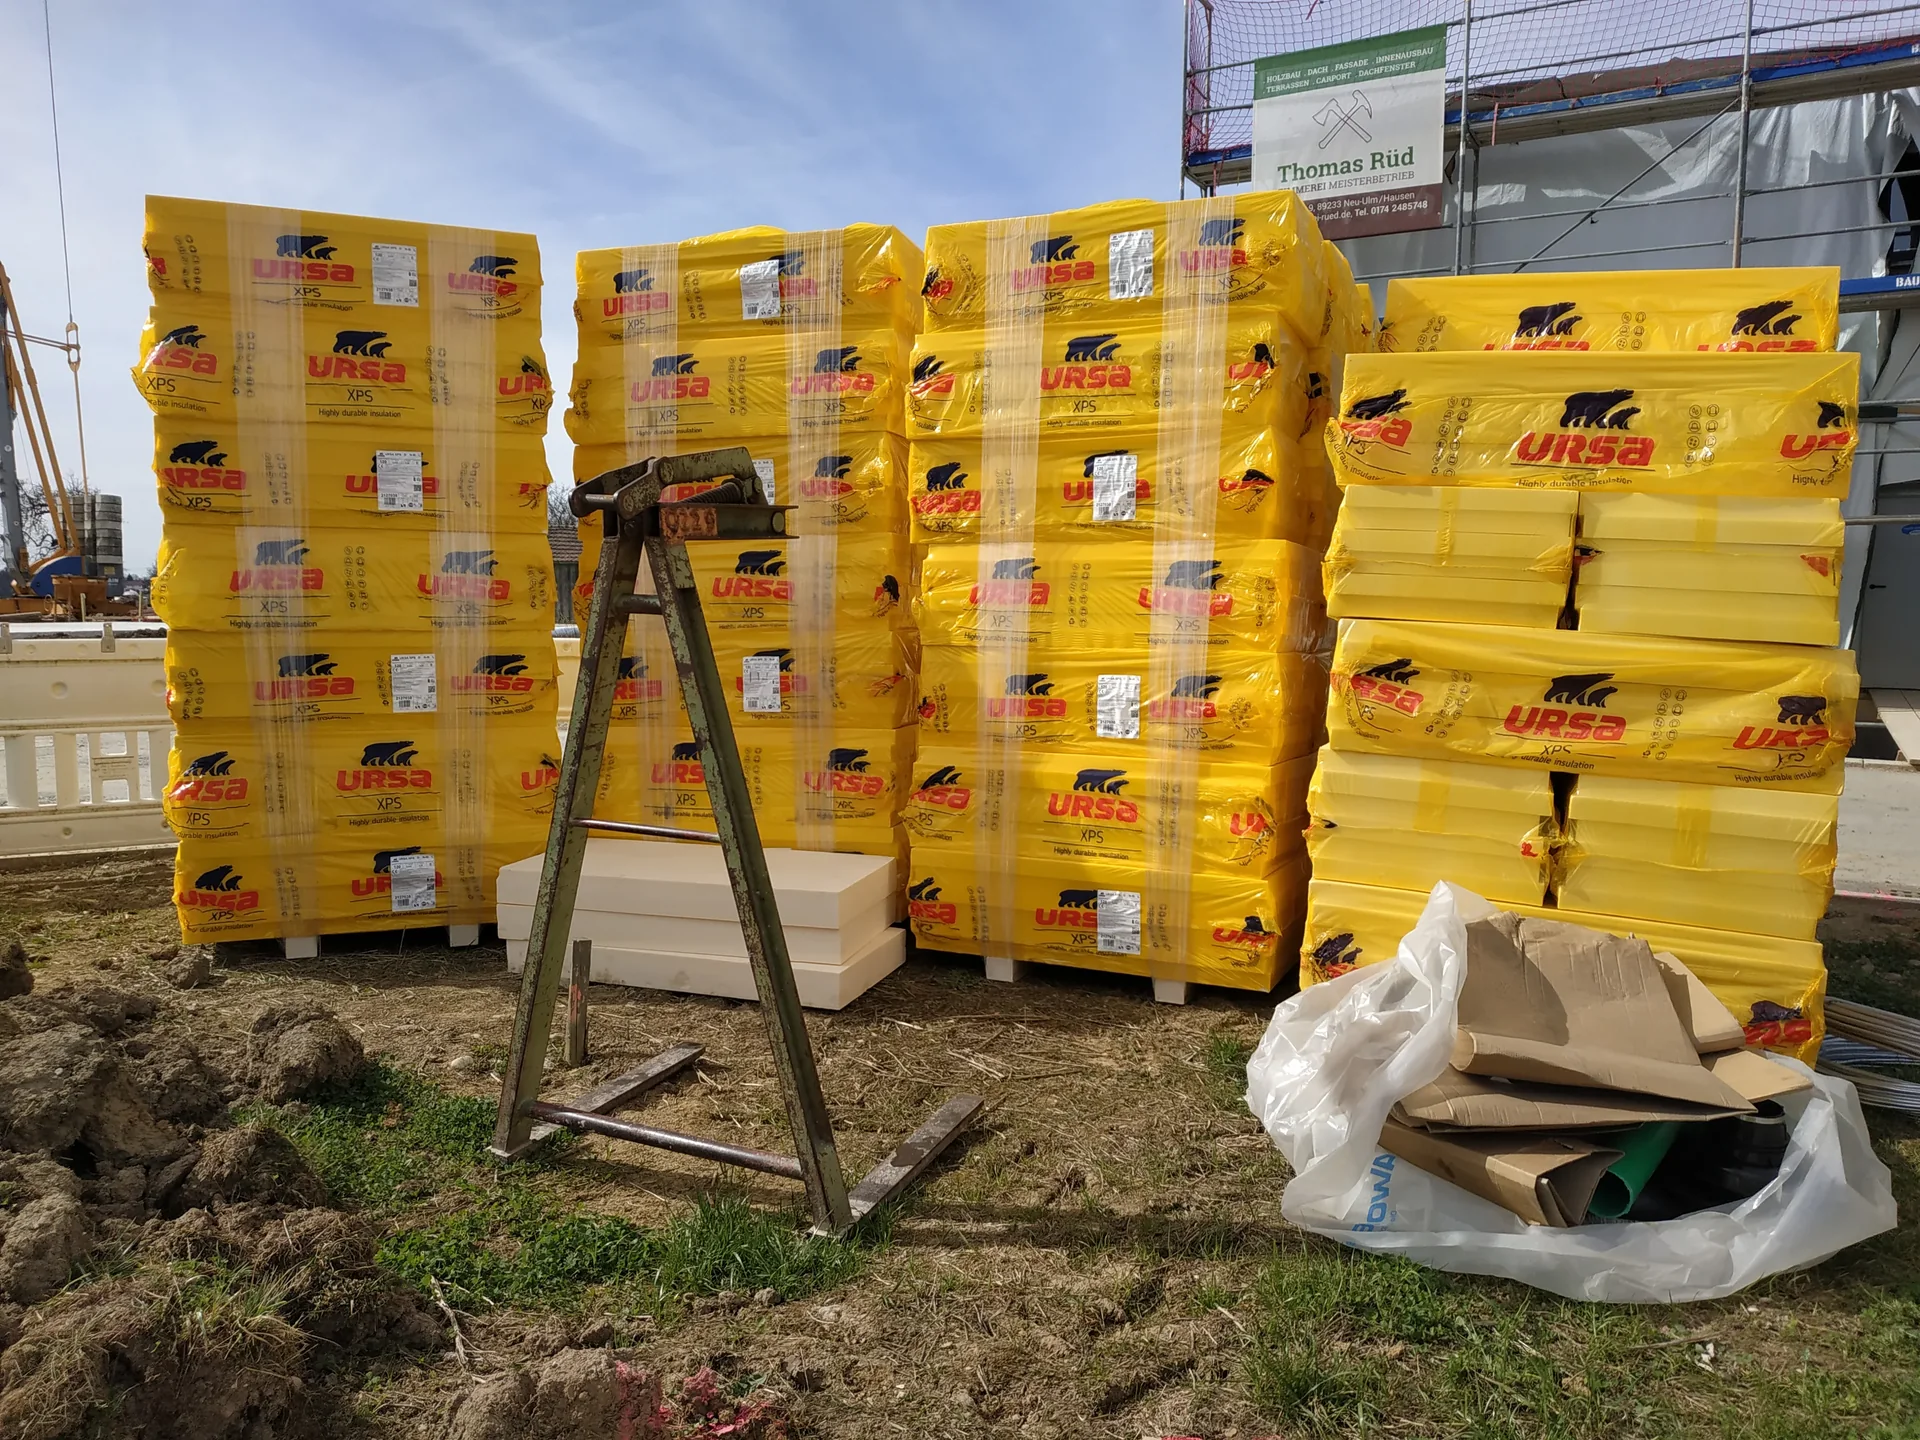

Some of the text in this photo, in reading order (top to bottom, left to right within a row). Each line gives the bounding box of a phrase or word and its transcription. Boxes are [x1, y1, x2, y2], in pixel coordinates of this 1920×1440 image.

[1267, 48, 1434, 83] HOLZBAU DACH FASSADE INNENAUSBAU
[1266, 62, 1415, 93] TERRASSEN CARPORT DACHFENSTER
[1278, 147, 1414, 182] Thomas Rüd
[1278, 171, 1414, 194] MEREI MEISTERBETRIEB
[1317, 201, 1341, 210] 89233
[1344, 192, 1415, 206] Neu-Ulm/Hausen
[1355, 208, 1369, 217] Tel.
[1371, 205, 1389, 215] 0174
[1392, 201, 1427, 212] 2485748
[1219, 275, 1240, 290] XPS
[294, 287, 321, 297] XPS
[781, 304, 800, 314] XPS
[628, 319, 645, 330] XPS
[147, 378, 175, 392] XPS
[348, 390, 373, 402] XPS
[171, 399, 206, 412] insulation
[825, 402, 846, 412] XPS
[1073, 400, 1096, 412] XPS
[319, 407, 340, 417] Highly
[659, 410, 679, 422] XPS
[1519, 479, 1546, 488] Highly
[187, 497, 211, 508] XPS
[260, 601, 287, 613] XPS
[457, 604, 481, 614] XPS
[742, 608, 764, 618] XPS
[991, 616, 1013, 627] XPS
[1175, 620, 1200, 631] XPS
[613, 680, 662, 700] RSA
[487, 696, 508, 704] XPS
[295, 704, 320, 714] XPS
[620, 706, 636, 716] XPS
[1016, 725, 1036, 735] XPS
[1185, 728, 1208, 739] XPS
[1540, 745, 1572, 755] XPS
[1554, 758, 1594, 769] insulation
[651, 764, 704, 783] URS
[377, 798, 402, 810] XPS
[676, 794, 696, 806] XPS
[186, 813, 210, 825] XPS
[349, 814, 429, 826] Highly durable insulation
[1080, 829, 1104, 843] XPS
[1054, 847, 1072, 855] Highly
[208, 911, 234, 921] XPS
[1035, 908, 1098, 928] URS
[224, 923, 253, 931] insulation
[1071, 934, 1096, 944] XPS
